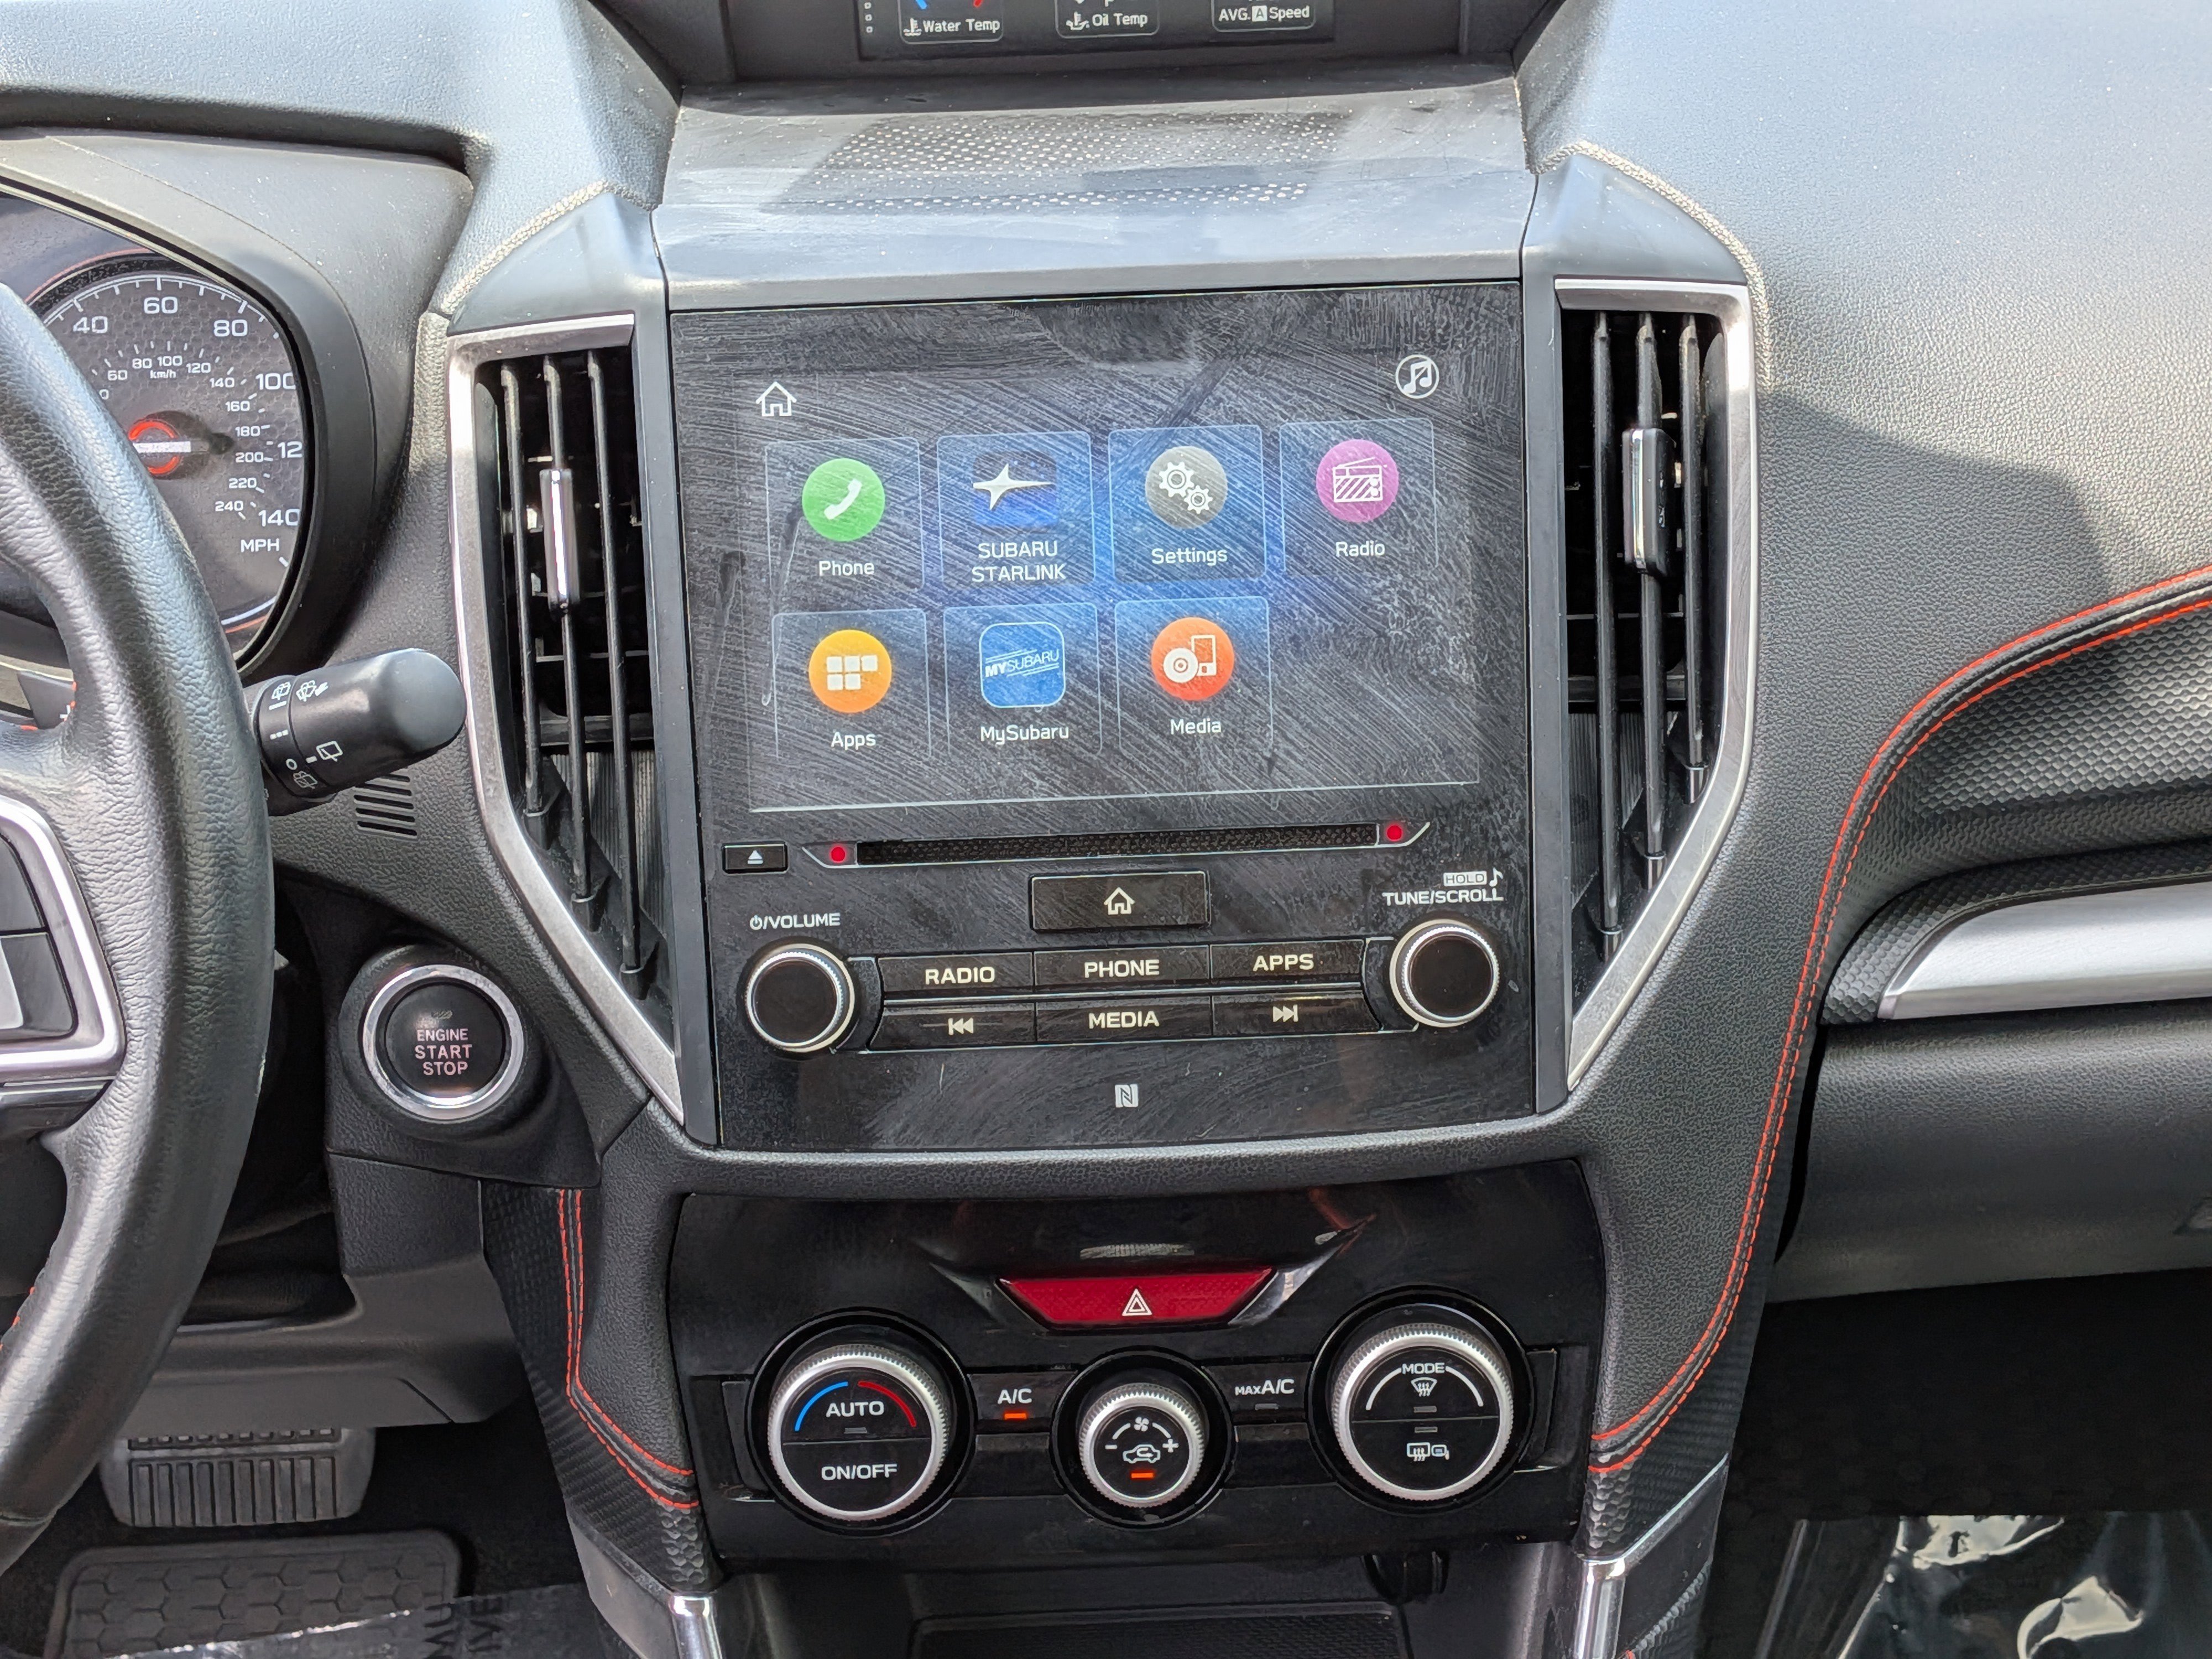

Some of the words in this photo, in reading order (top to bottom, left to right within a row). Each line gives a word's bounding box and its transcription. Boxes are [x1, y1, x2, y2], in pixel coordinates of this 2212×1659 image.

[1092, 13, 1109, 26] Oil
[1113, 13, 1148, 28] Temp
[1269, 5, 1310, 22] Speed
[923, 20, 961, 33] Water
[966, 18, 1000, 33] Temp
[144, 296, 178, 314] 60
[73, 316, 108, 334] 40
[213, 319, 248, 337] 80
[132, 358, 153, 369] 80
[157, 356, 182, 367] 100
[186, 362, 211, 374] 120
[107, 370, 128, 381] 60
[150, 369, 176, 379] km/h
[209, 377, 235, 388] 140
[99, 389, 109, 400] 0
[225, 400, 251, 412] 160
[235, 425, 261, 437] 180
[235, 451, 264, 463] 200
[277, 441, 304, 459] 12
[228, 477, 257, 489] 220
[215, 500, 244, 512] 240
[258, 508, 300, 527] 140
[240, 538, 280, 552] MPH
[978, 540, 1058, 559] SUBARU
[1335, 541, 1385, 557] Radio
[1151, 549, 1228, 567] Settings
[818, 561, 875, 576] Phone
[971, 562, 1067, 583] STARLINK
[1170, 718, 1222, 735] Media
[831, 732, 877, 749] Apps
[980, 725, 1070, 745] MySubaru
[1445, 873, 1485, 885] HOLD
[1381, 888, 1504, 906] TUNE/SCROLL
[1084, 959, 1160, 978] PHONE
[1252, 953, 1314, 972] APPS
[925, 966, 995, 985] RADIO
[1088, 1010, 1160, 1029] MEDIA
[417, 1028, 468, 1042] ENGINE
[415, 1044, 473, 1060] START
[422, 1061, 468, 1076] STOP
[1401, 1362, 1446, 1375] MODE
[998, 1388, 1032, 1405] A/C
[826, 1401, 885, 1418] AUTO
[821, 1463, 898, 1481] ON/OFF
